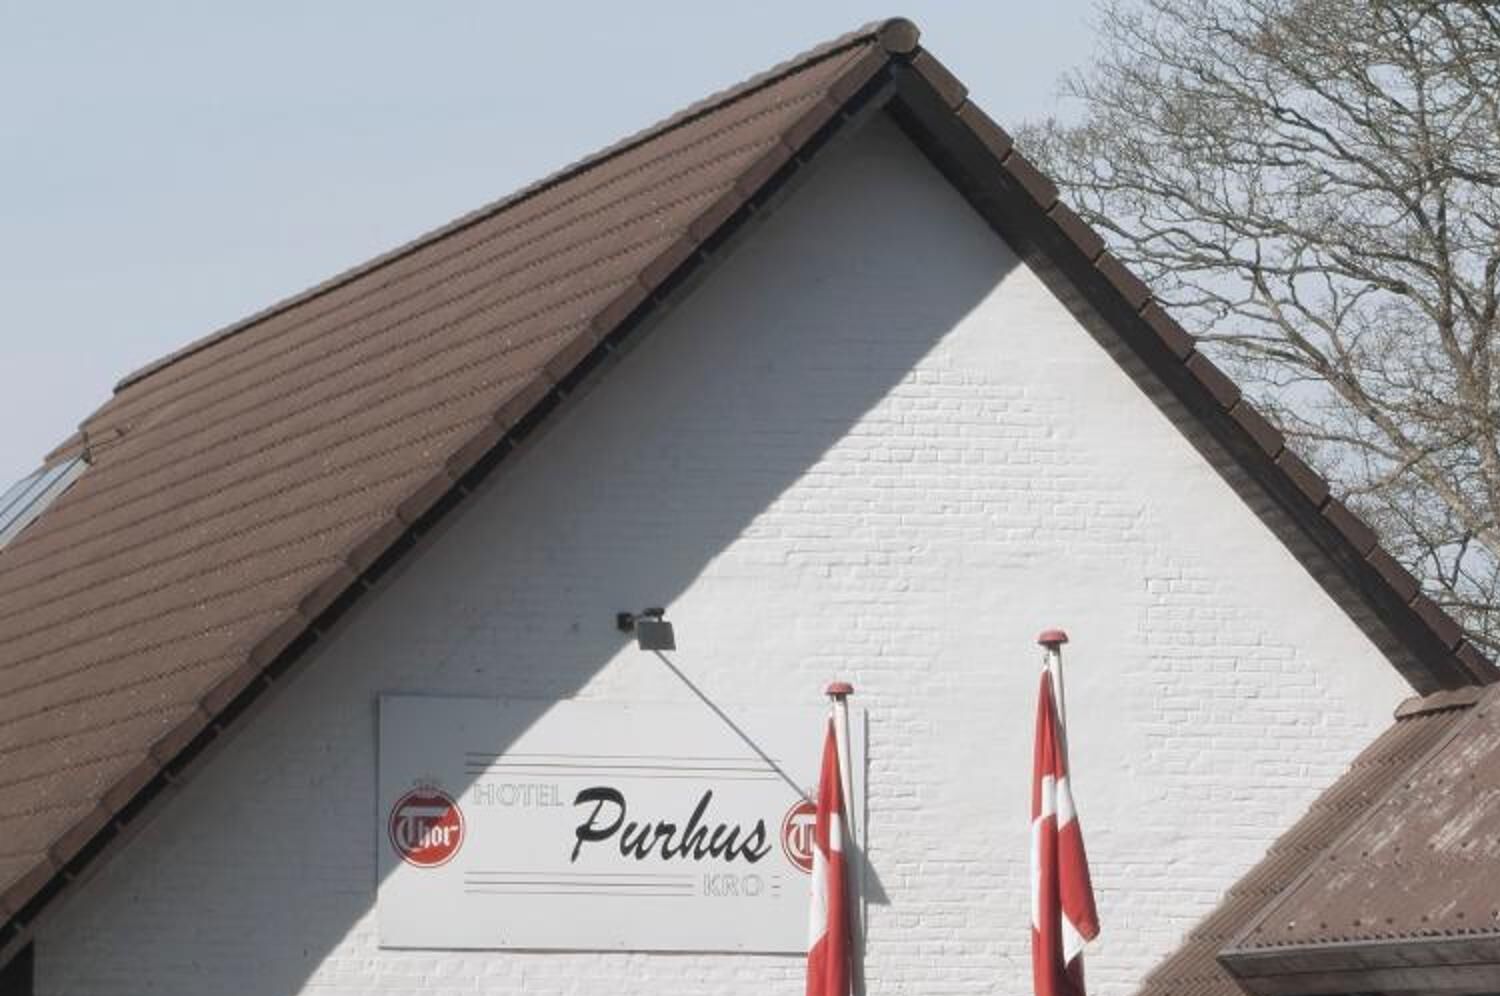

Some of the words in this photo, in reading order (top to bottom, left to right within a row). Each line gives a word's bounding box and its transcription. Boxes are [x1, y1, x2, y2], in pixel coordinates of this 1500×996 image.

[396, 805, 459, 852] Thor
[472, 782, 565, 808] HOTEL
[570, 785, 773, 864] Purhus
[703, 873, 764, 897] KRO
